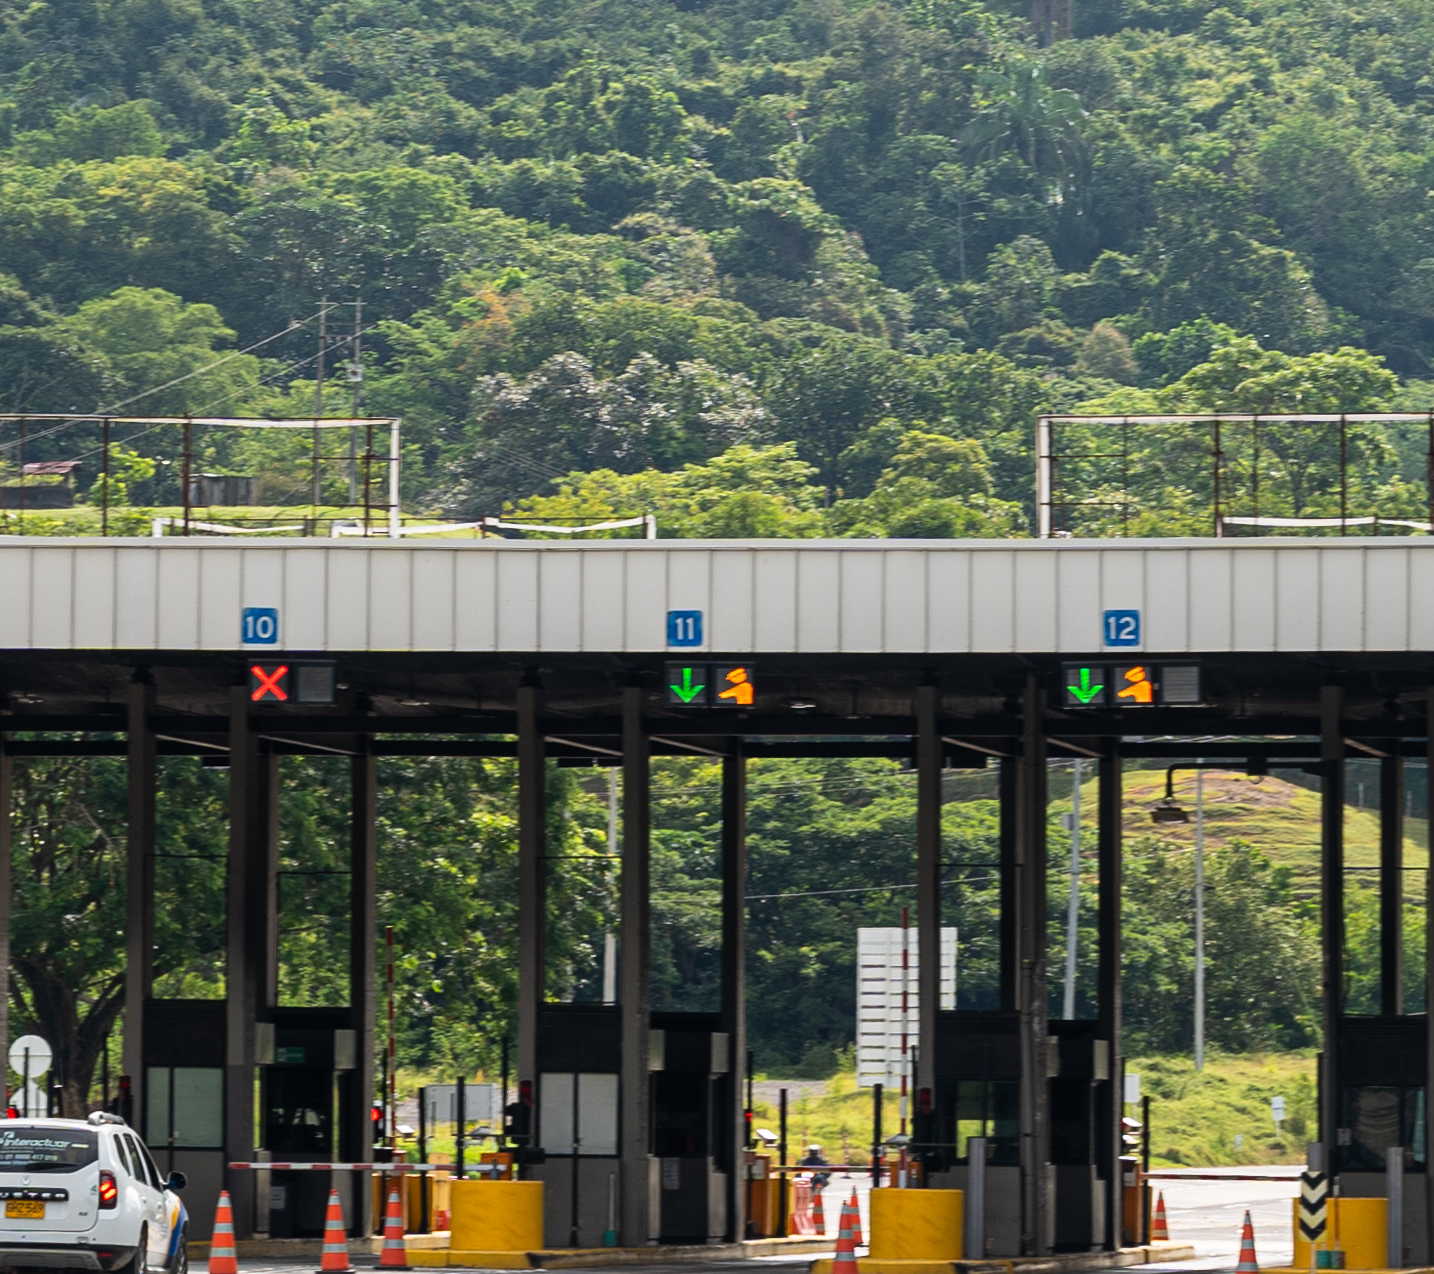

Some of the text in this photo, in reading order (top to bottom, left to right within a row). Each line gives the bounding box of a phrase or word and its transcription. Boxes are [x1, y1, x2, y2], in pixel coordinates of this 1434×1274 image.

[246, 615, 274, 639] 10
[675, 617, 695, 640] 11
[1107, 615, 1136, 640] 12
